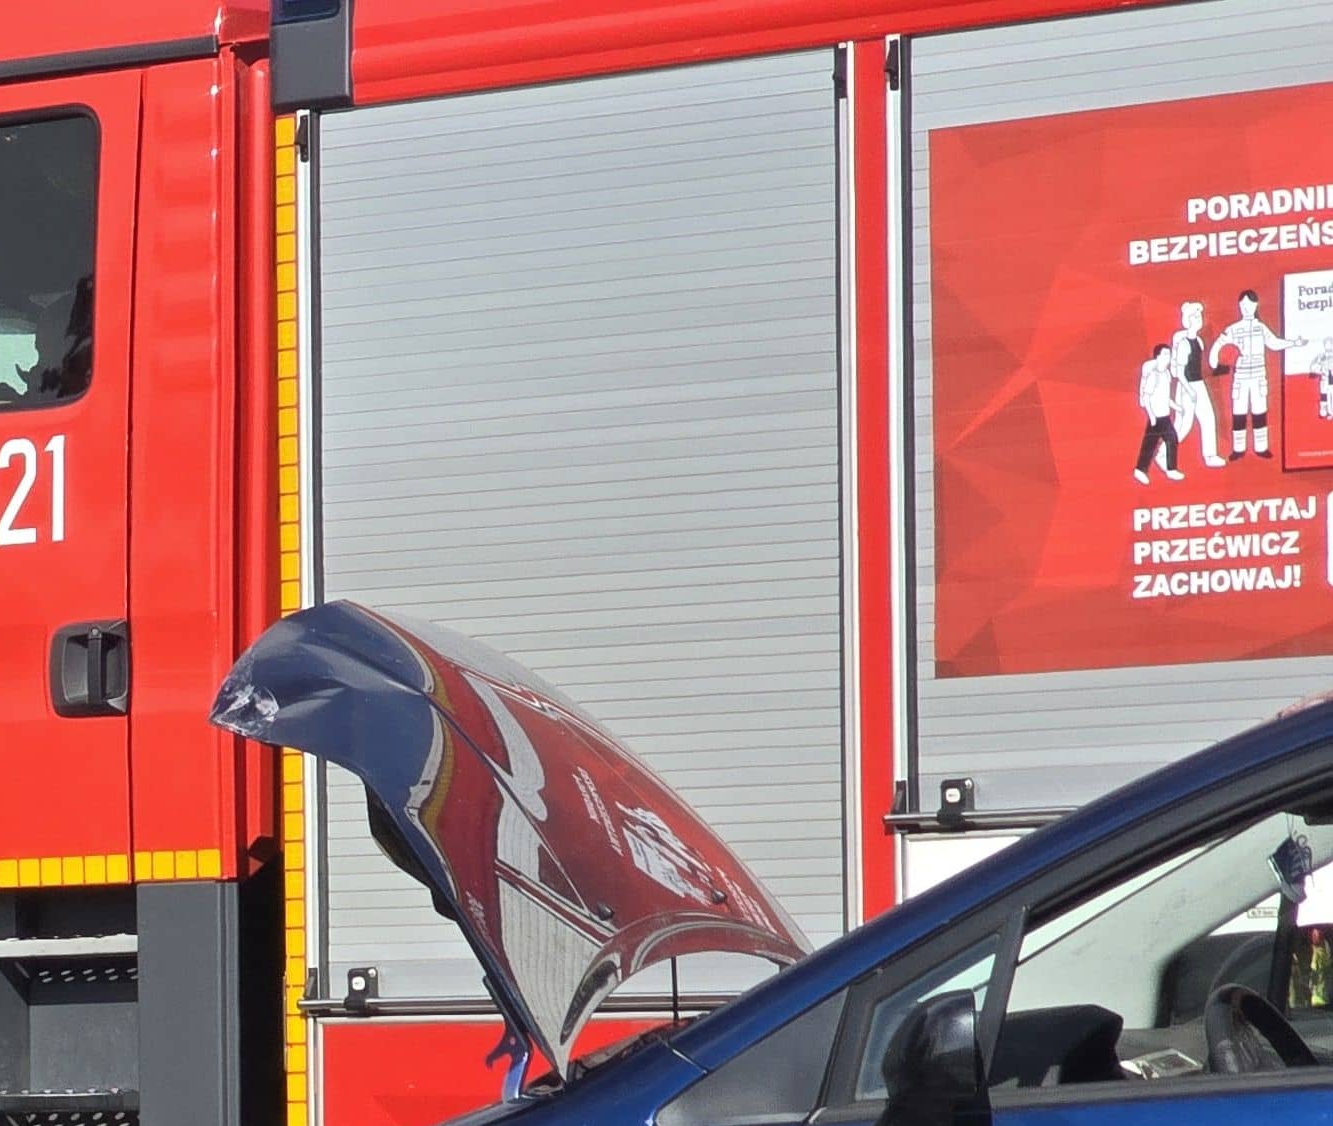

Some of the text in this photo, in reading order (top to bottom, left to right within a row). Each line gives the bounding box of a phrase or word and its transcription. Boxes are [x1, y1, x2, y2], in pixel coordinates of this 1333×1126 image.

[1134, 496, 1316, 532] PRZECZYTAJ
[1134, 531, 1300, 565] PRZEĆWICZ
[1133, 565, 1301, 598] ZACHOWAJ!
